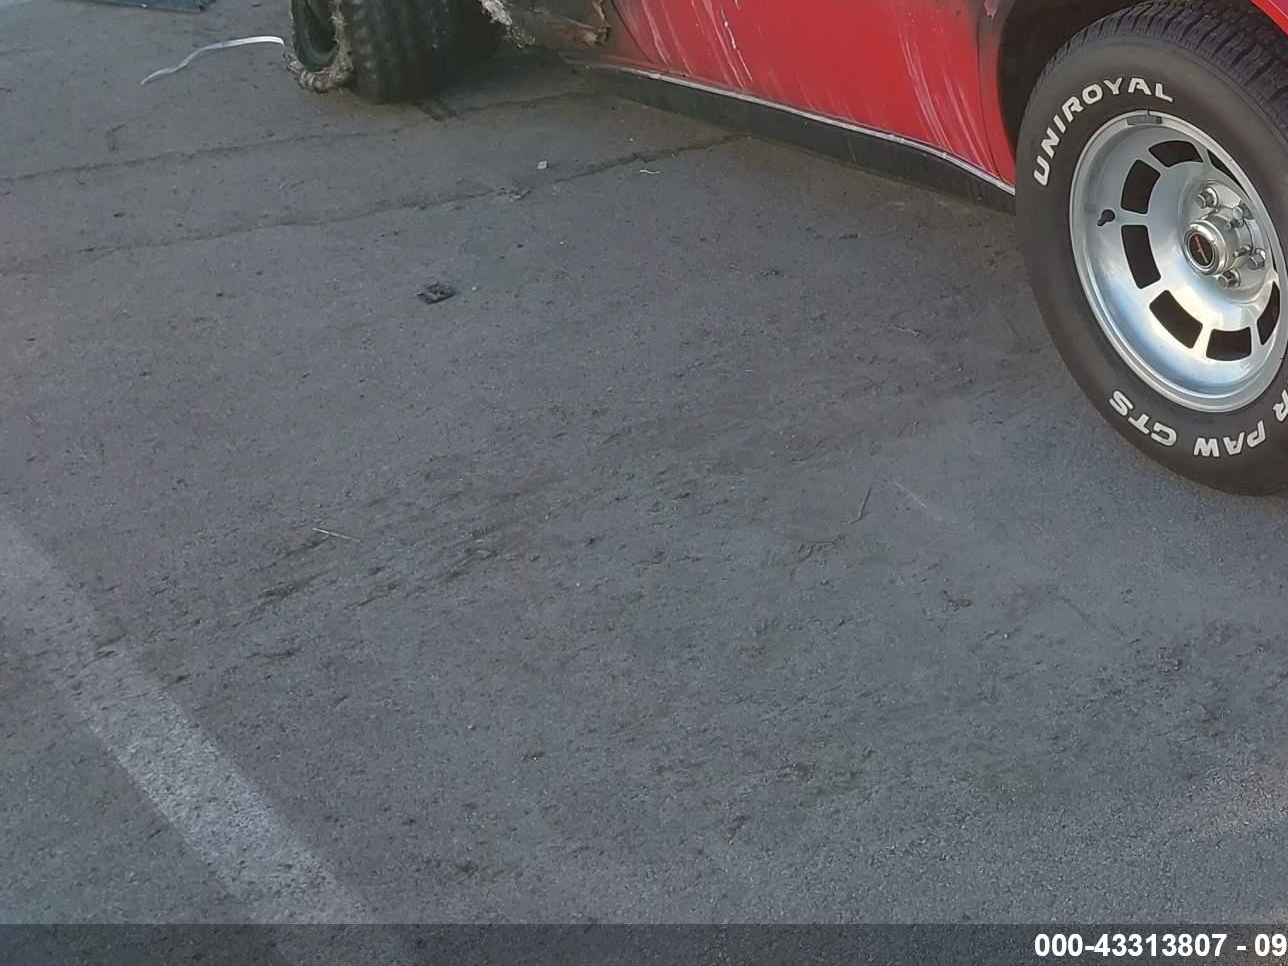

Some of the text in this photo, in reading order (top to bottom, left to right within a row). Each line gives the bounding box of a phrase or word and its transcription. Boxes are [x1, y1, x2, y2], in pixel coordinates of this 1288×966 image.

[1033, 77, 1174, 187] UNIROYAL
[1108, 389, 1178, 447] GTS
[1193, 425, 1267, 458] PAW
